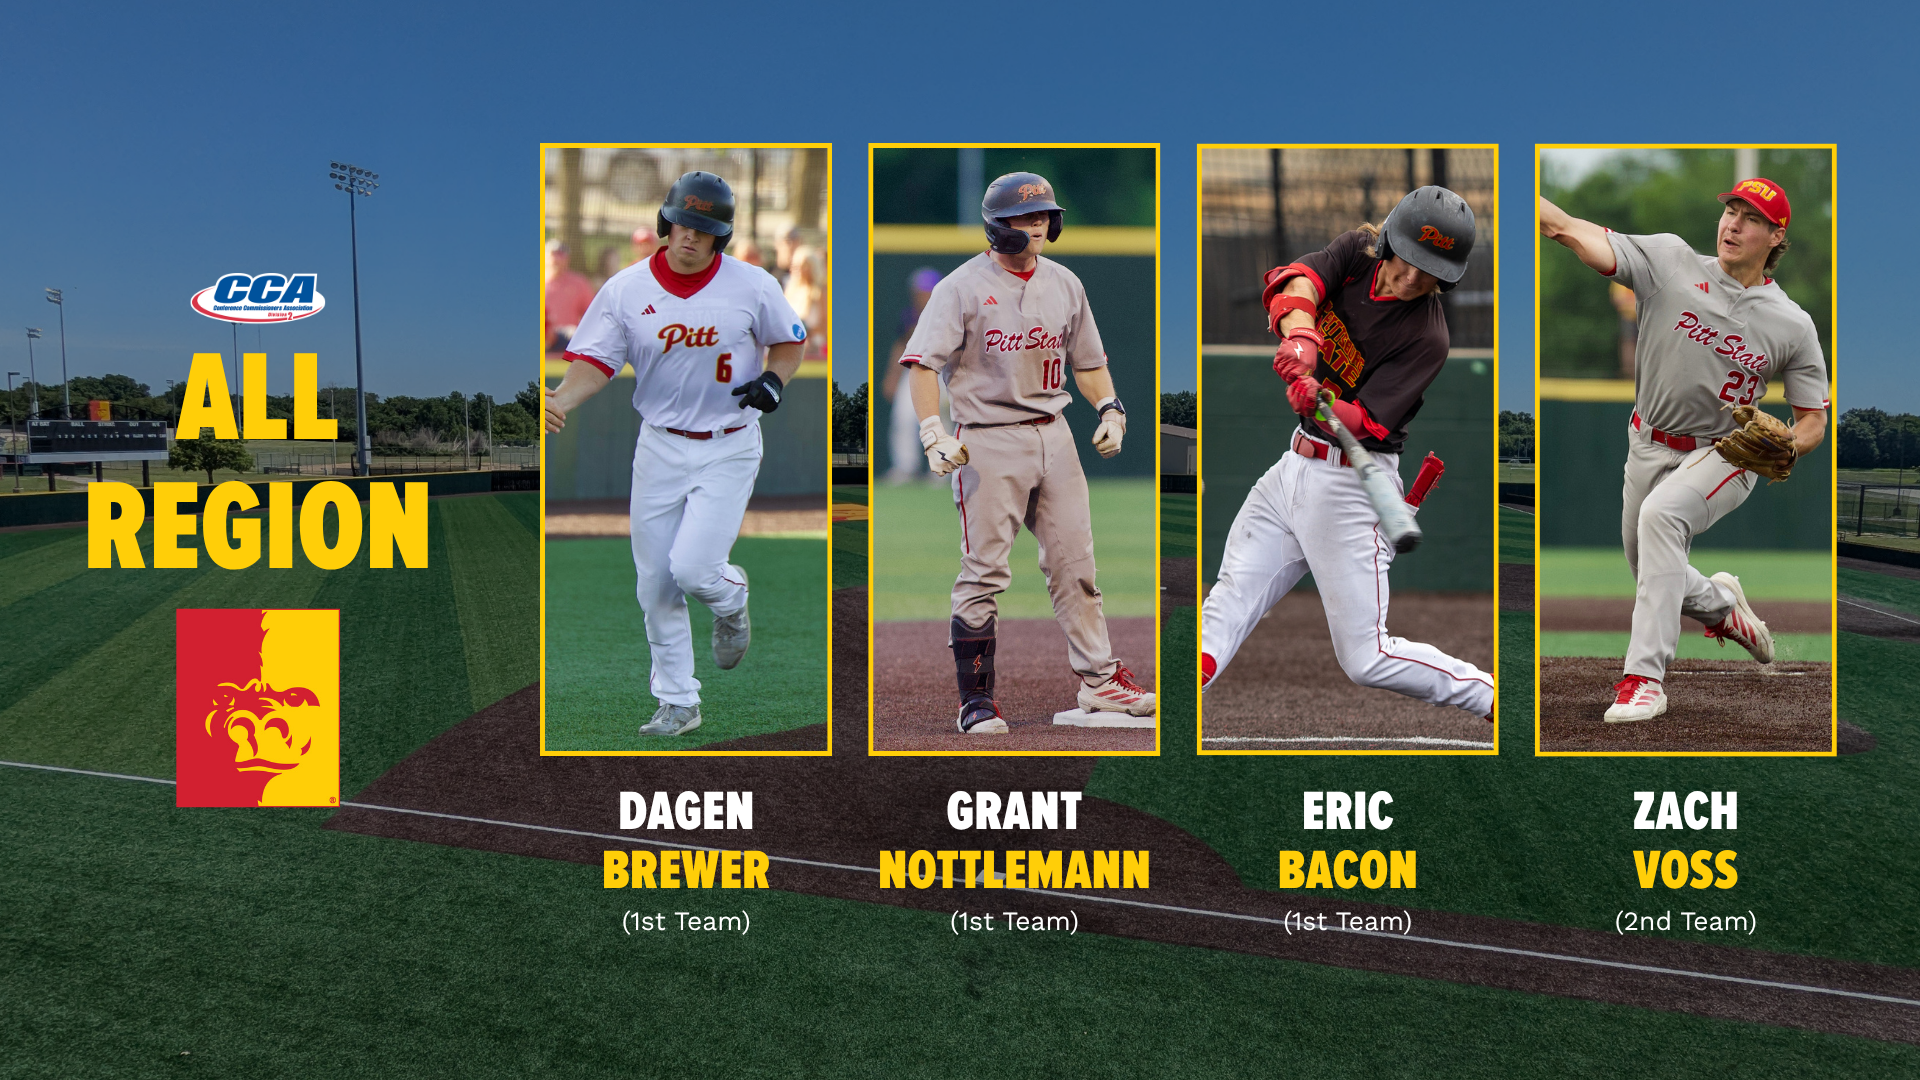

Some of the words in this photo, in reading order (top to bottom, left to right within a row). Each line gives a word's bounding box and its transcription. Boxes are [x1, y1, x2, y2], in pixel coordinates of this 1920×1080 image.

[684, 194, 714, 212] Pitt
[1018, 183, 1047, 201] Pitt
[1737, 181, 1777, 201] PSU
[1418, 225, 1455, 250] Pitt
[657, 323, 720, 354] Pitt
[984, 328, 1023, 353] Pitt
[1673, 310, 1719, 346] Pitt
[1714, 334, 1769, 372] State
[715, 353, 733, 383] 6
[1042, 357, 1061, 390] 10
[1718, 370, 1760, 405] 23
